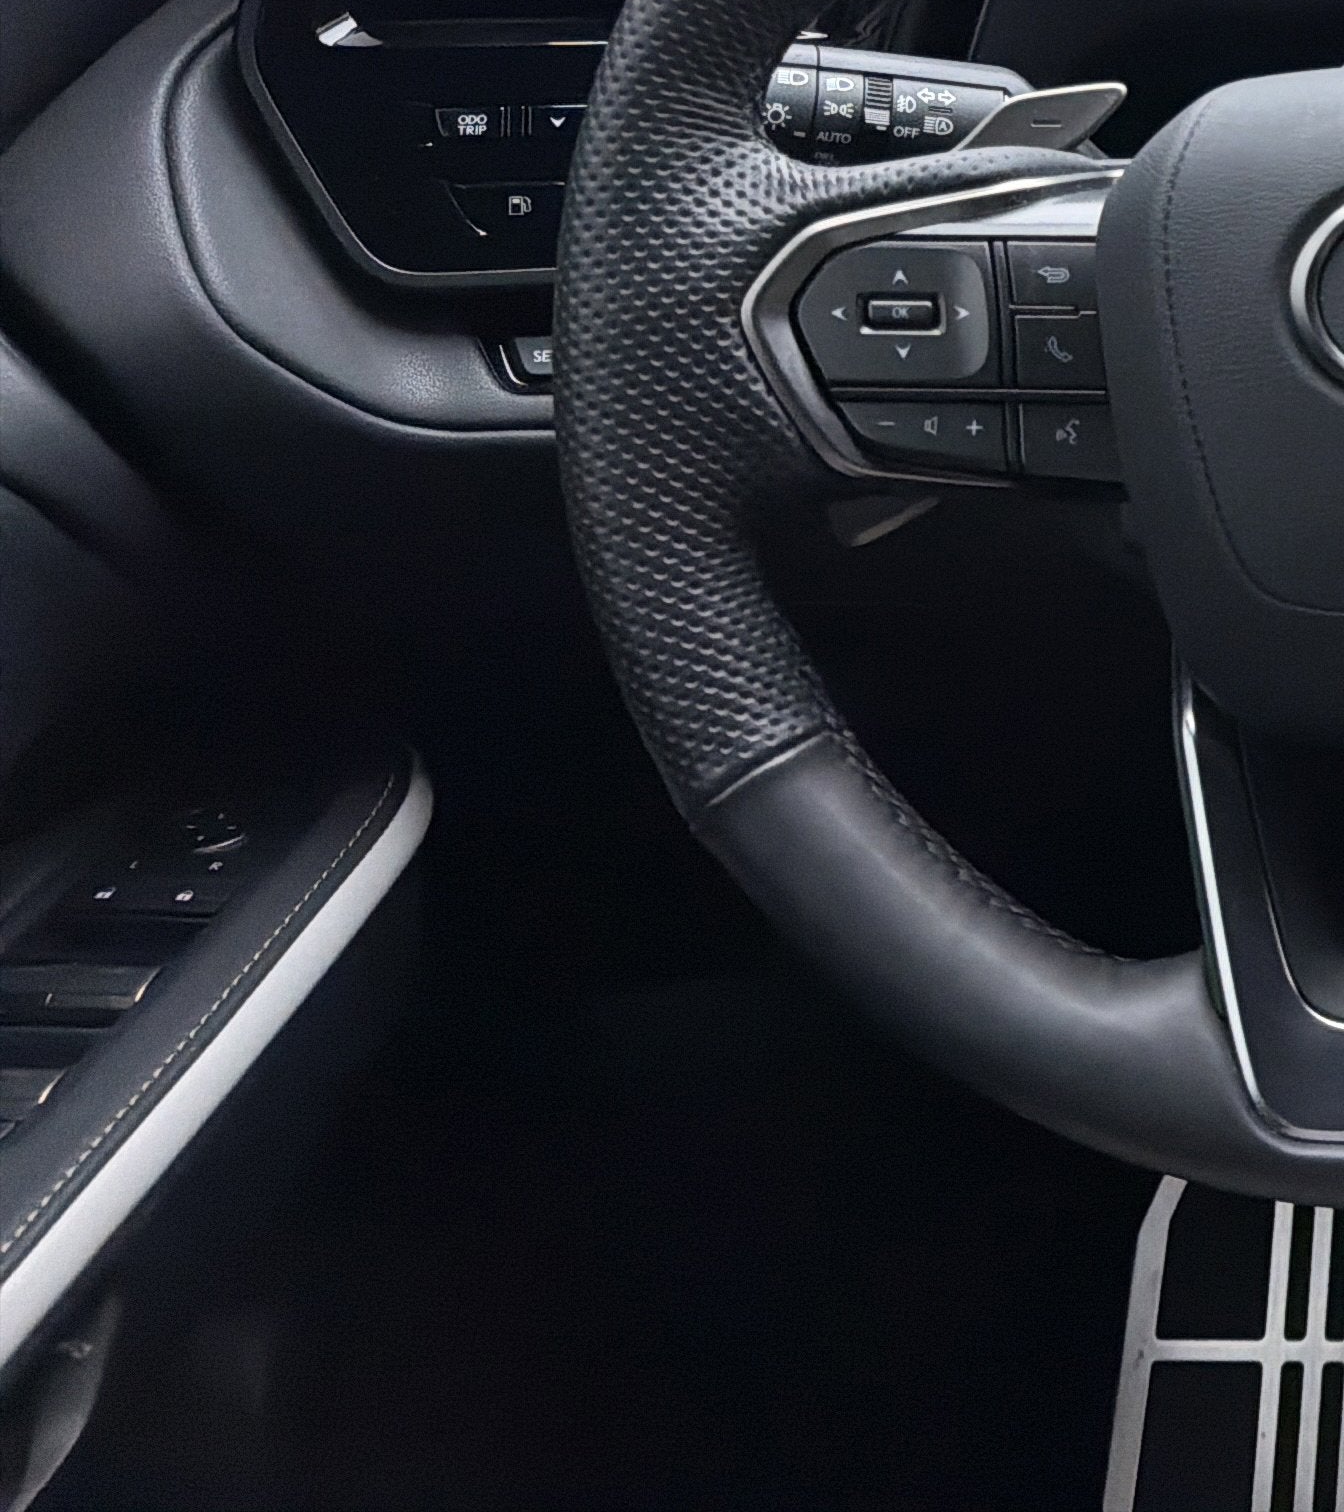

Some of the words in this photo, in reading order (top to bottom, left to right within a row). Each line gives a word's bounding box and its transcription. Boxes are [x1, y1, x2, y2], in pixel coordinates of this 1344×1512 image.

[458, 114, 488, 125] ODO
[458, 125, 488, 136] TRIP
[893, 126, 920, 138] OFF
[817, 131, 851, 144] AUTO
[892, 306, 910, 318] OK
[533, 349, 553, 363] SE
